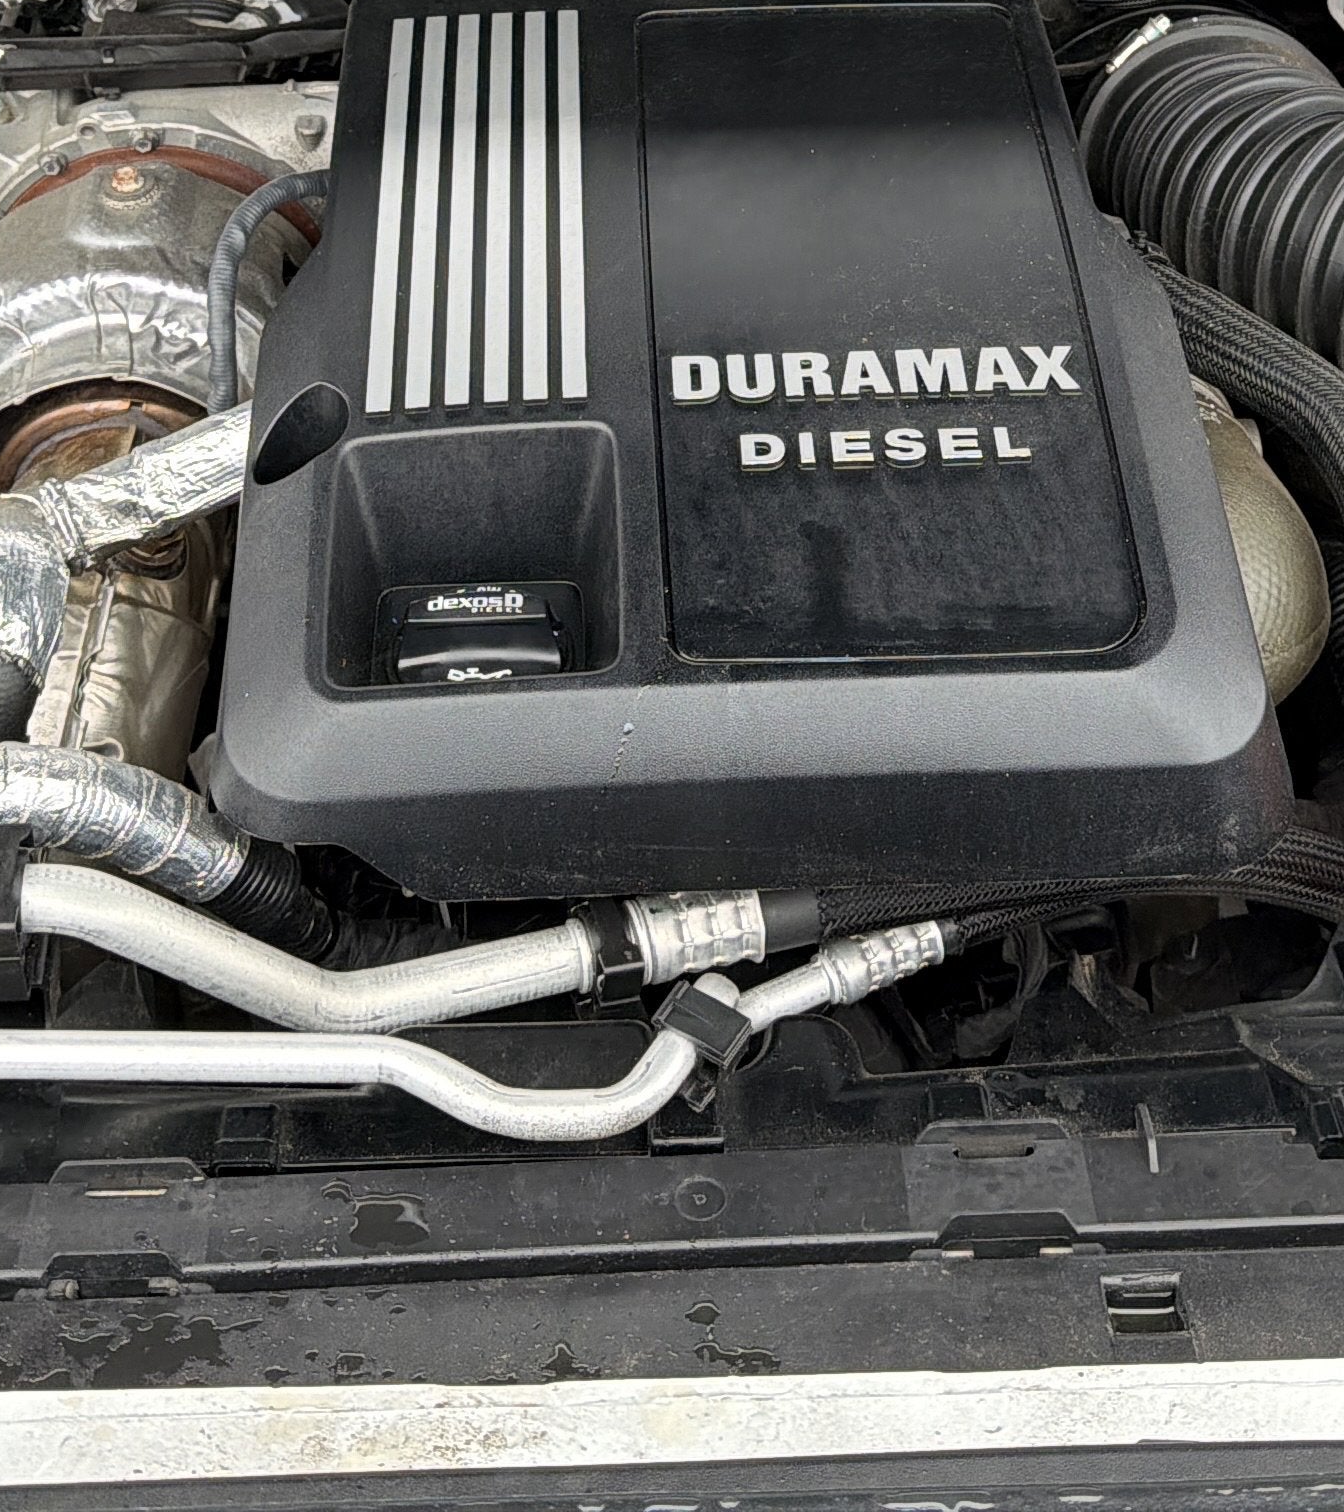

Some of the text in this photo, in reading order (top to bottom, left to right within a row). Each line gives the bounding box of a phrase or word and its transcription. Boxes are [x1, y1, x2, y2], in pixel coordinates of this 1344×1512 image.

[671, 345, 1083, 405] DURAMAX
[739, 426, 1033, 471] DIESEL
[470, 606, 523, 614] DIESEL
